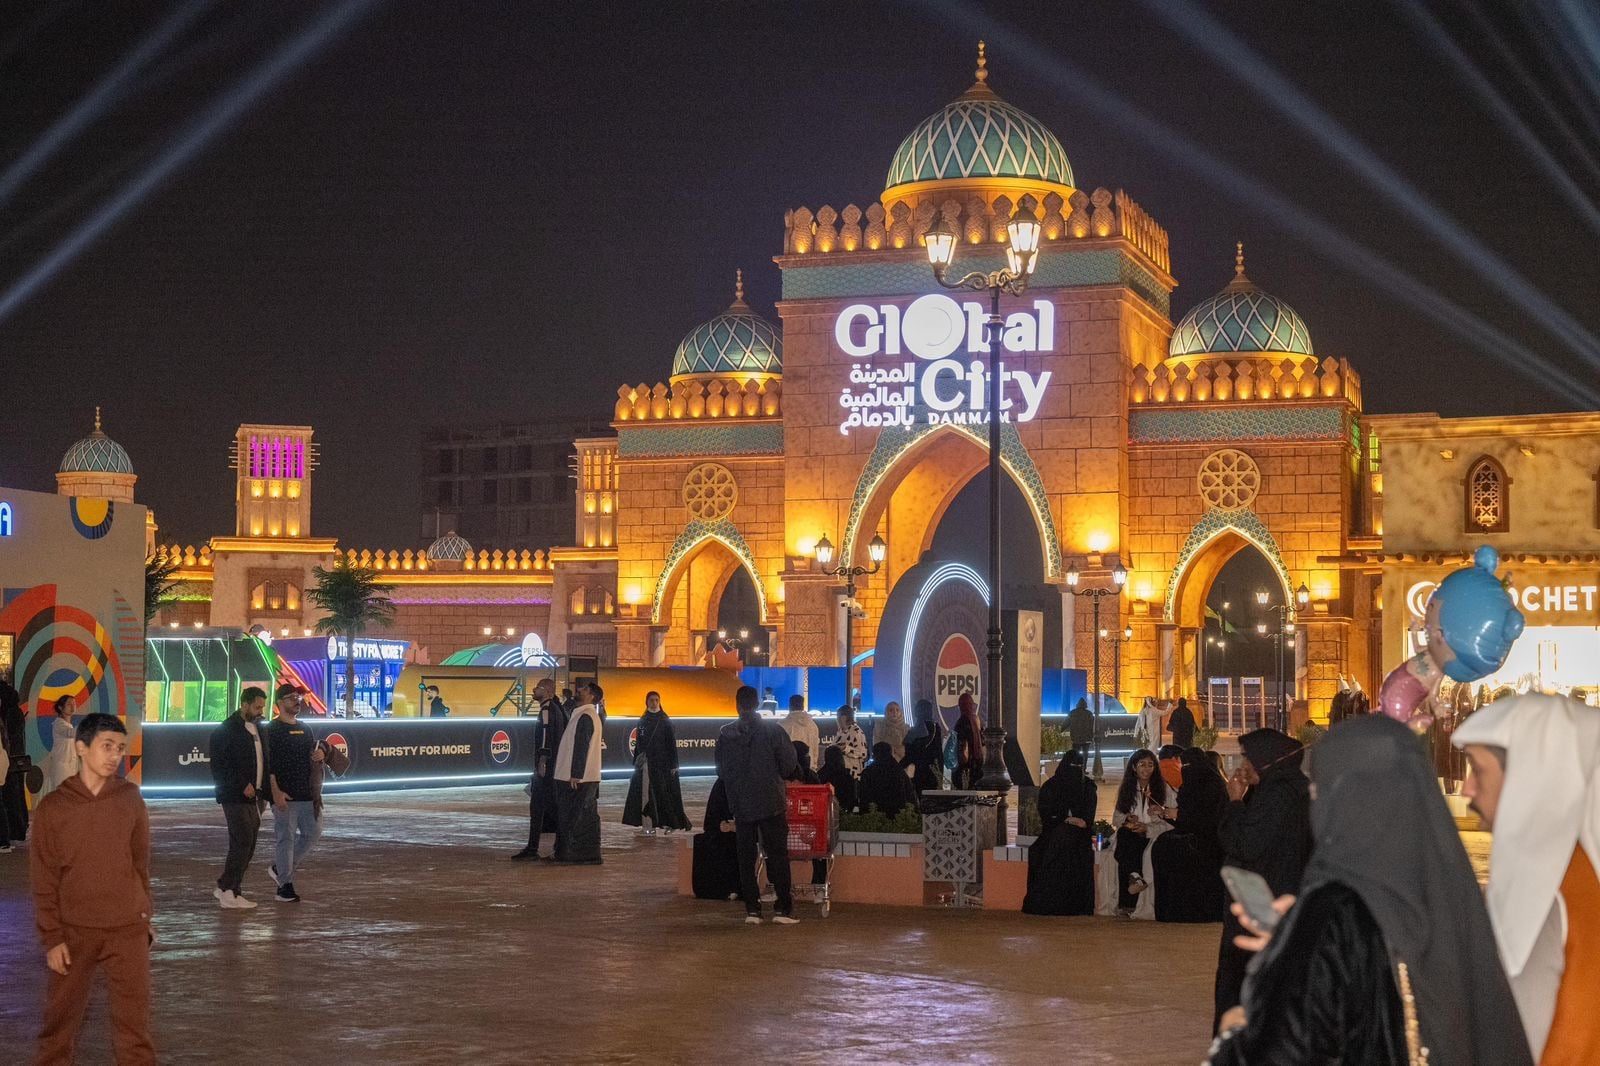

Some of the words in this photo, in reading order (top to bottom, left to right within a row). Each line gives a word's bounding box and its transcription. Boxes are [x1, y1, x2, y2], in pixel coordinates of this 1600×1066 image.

[849, 362, 916, 389] المدينة
[839, 386, 915, 414] العالمية
[839, 408, 915, 436] بالدمام
[937, 674, 978, 696] PEPSI
[371, 745, 418, 757] THIRSTY
[420, 745, 440, 756] FOR
[441, 744, 471, 755] MORE
[492, 742, 509, 751] PEPSI
[700, 739, 716, 748] FOR
